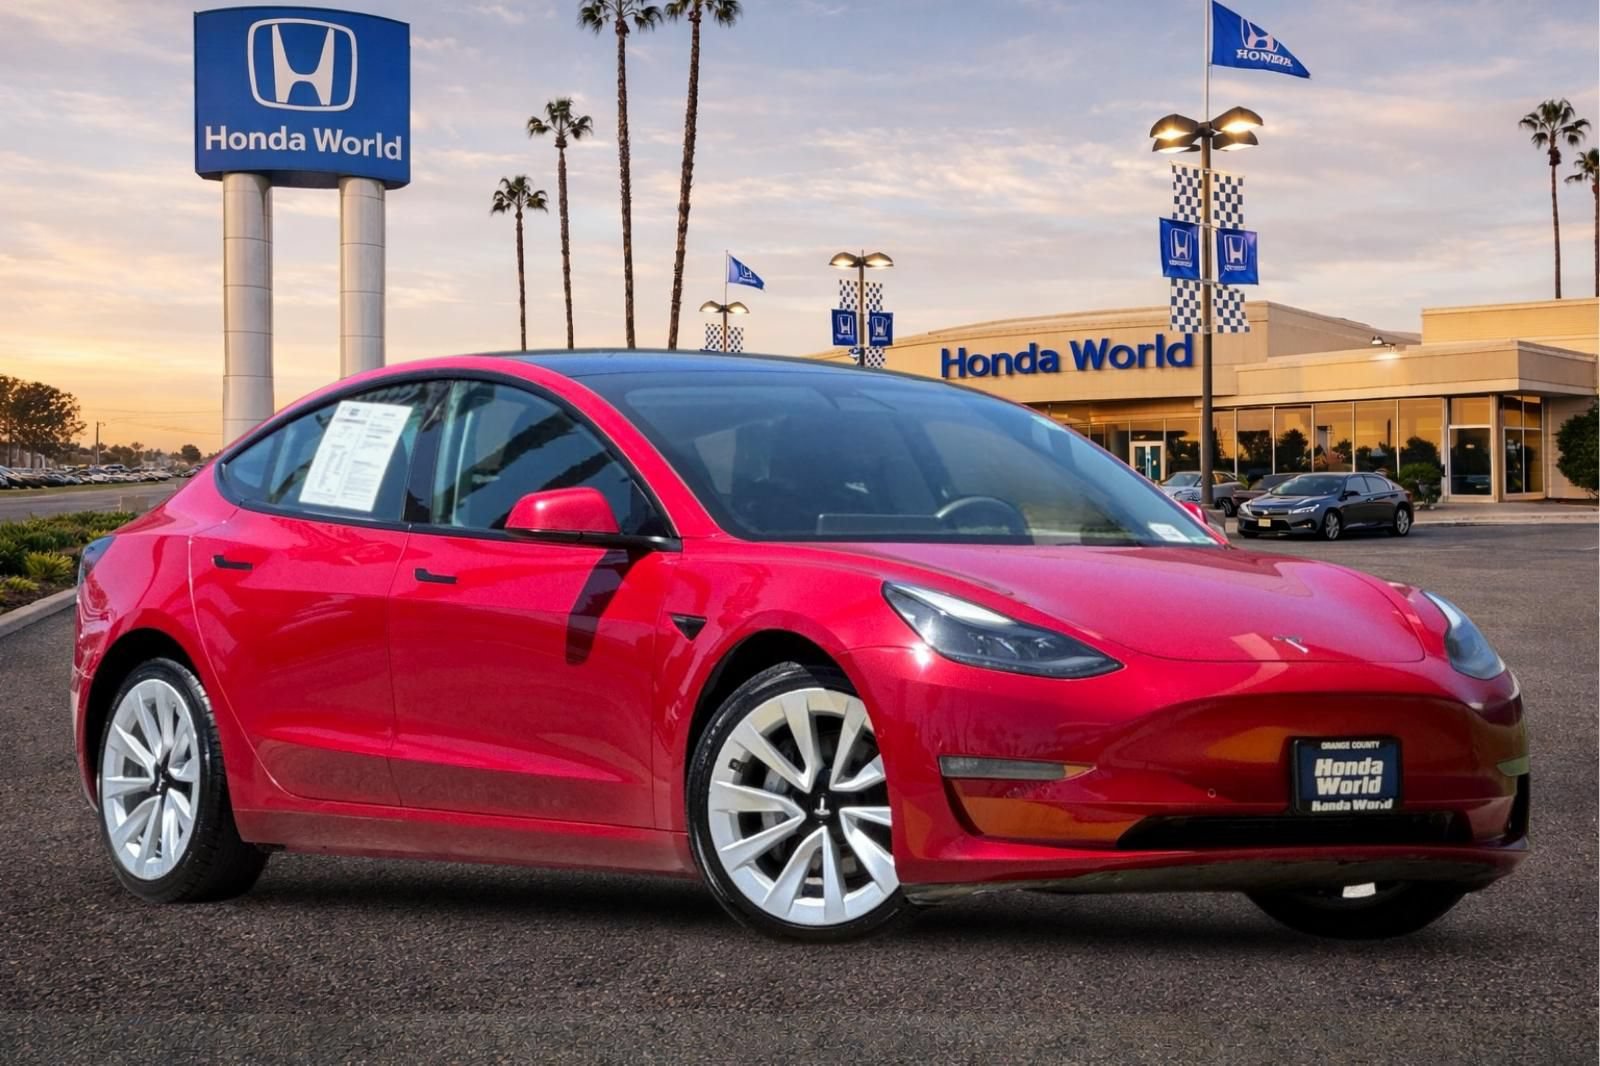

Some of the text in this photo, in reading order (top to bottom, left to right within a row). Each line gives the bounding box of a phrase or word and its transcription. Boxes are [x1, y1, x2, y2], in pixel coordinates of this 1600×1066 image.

[205, 125, 402, 161] Honda World
[941, 333, 1193, 378] Honda World
[1321, 741, 1380, 750] ORANGE COUNTY
[1315, 757, 1384, 777] Honda
[1317, 776, 1382, 795] World
